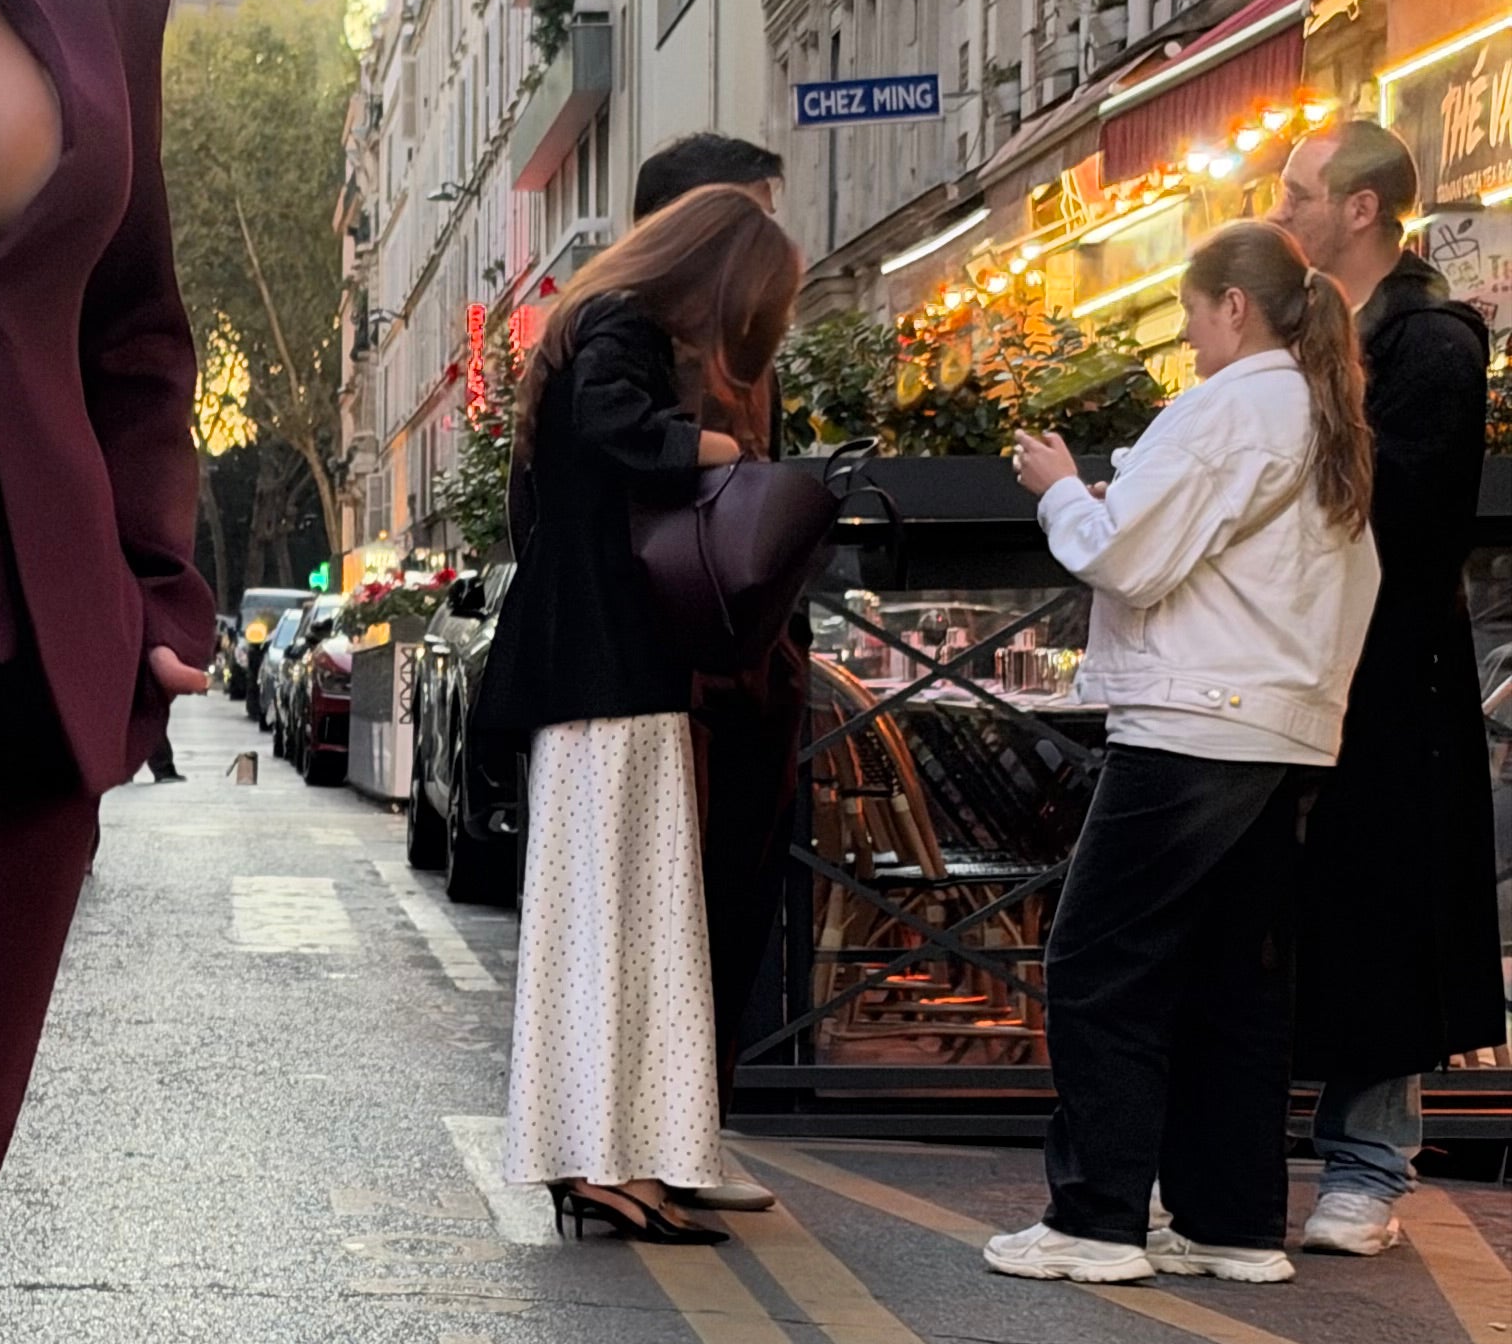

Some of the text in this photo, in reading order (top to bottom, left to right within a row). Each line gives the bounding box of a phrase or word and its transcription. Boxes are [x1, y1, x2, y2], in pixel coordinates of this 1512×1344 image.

[803, 83, 933, 117] CHEZ MING
[1440, 44, 1489, 179] THÉ
